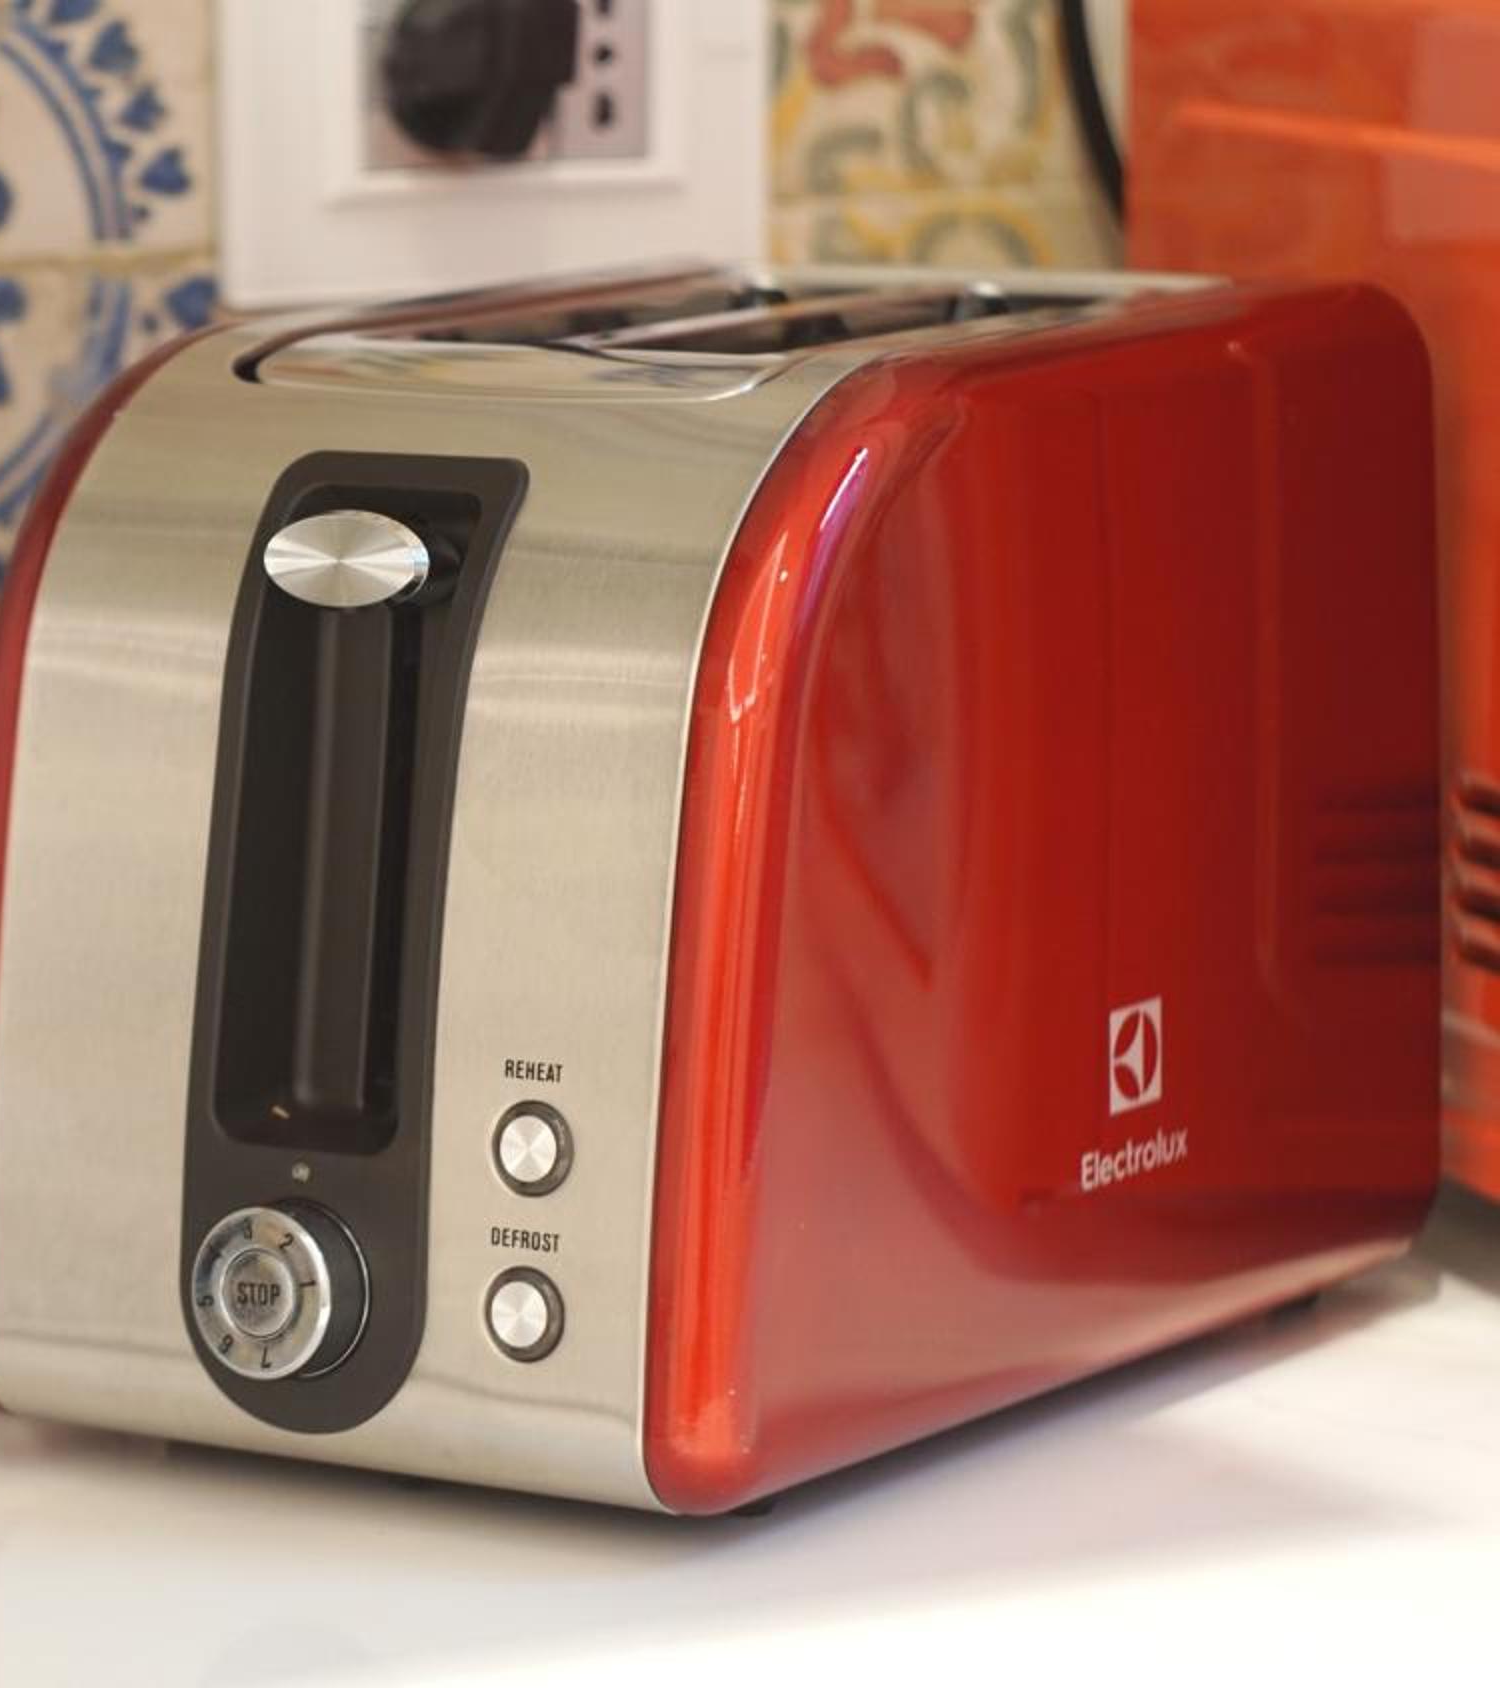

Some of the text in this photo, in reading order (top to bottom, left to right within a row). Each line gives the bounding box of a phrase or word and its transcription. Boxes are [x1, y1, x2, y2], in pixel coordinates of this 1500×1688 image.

[504, 1058, 564, 1084] REHEAT
[1080, 1126, 1190, 1193] Electrolux
[278, 1232, 295, 1252] 2
[491, 1226, 561, 1254] DEFROST
[236, 1281, 281, 1307] STOP
[299, 1279, 317, 1289] 1
[196, 1294, 215, 1308] 5
[219, 1334, 235, 1356] 6
[260, 1346, 272, 1369] 7
